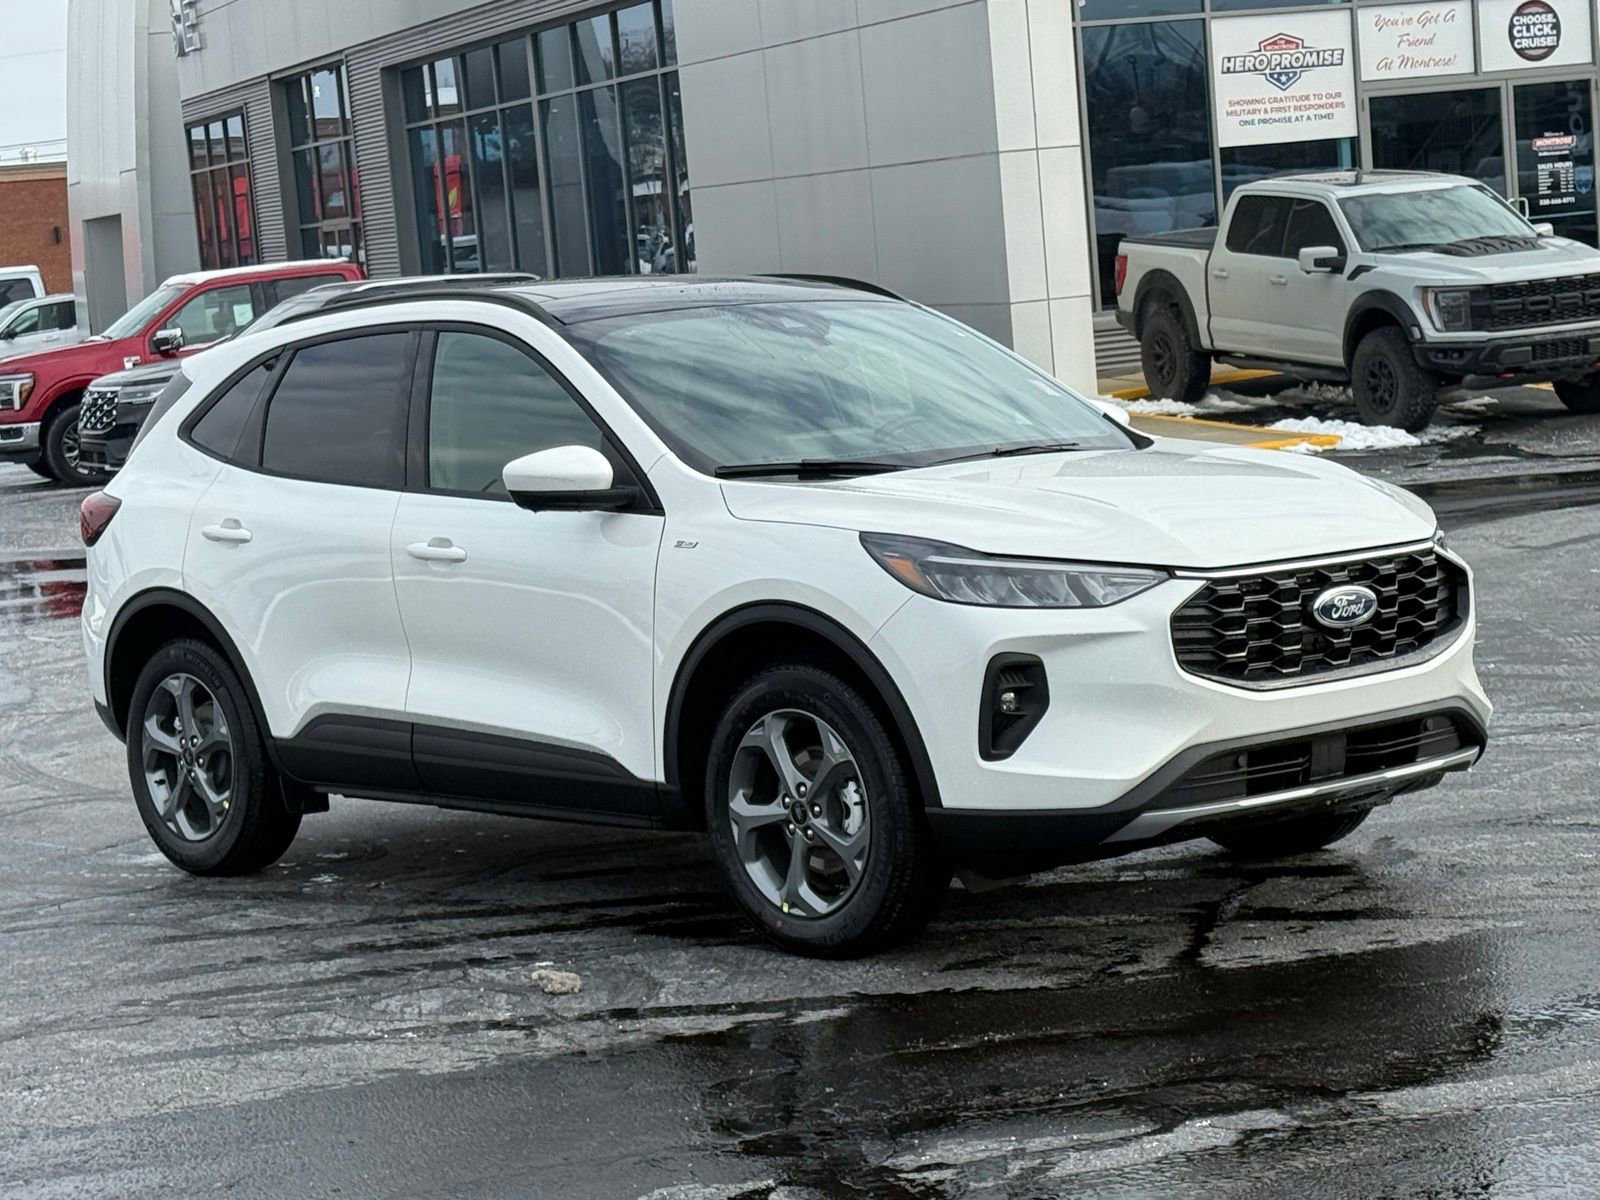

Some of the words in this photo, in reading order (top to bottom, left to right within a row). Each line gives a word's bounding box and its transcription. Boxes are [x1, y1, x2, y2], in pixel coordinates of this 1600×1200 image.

[1374, 12, 1413, 32] You've
[1417, 10, 1440, 29] Got
[1443, 9, 1456, 22] A
[1513, 13, 1556, 25] CHOOSE.
[1513, 24, 1556, 37] CLICK.
[1397, 33, 1436, 48] Friend
[1514, 36, 1557, 49] CRUISE!
[1221, 53, 1269, 74] HERO
[1270, 48, 1344, 70] PROMISE
[1376, 57, 1393, 71] At
[1398, 54, 1456, 69] Montrose!
[1228, 97, 1266, 107] SHOWING
[1267, 94, 1311, 105] GRATITUDE
[1313, 93, 1323, 101] TO
[1226, 107, 1262, 117] MILITARY
[1270, 105, 1291, 114] FIRST
[1293, 101, 1345, 112] RESPONDERS
[1239, 118, 1256, 127] ONE
[1257, 115, 1292, 125] PROMISE
[1294, 114, 1304, 122] AT
[1314, 113, 1334, 121] TIME!
[1331, 594, 1365, 619] Ford
